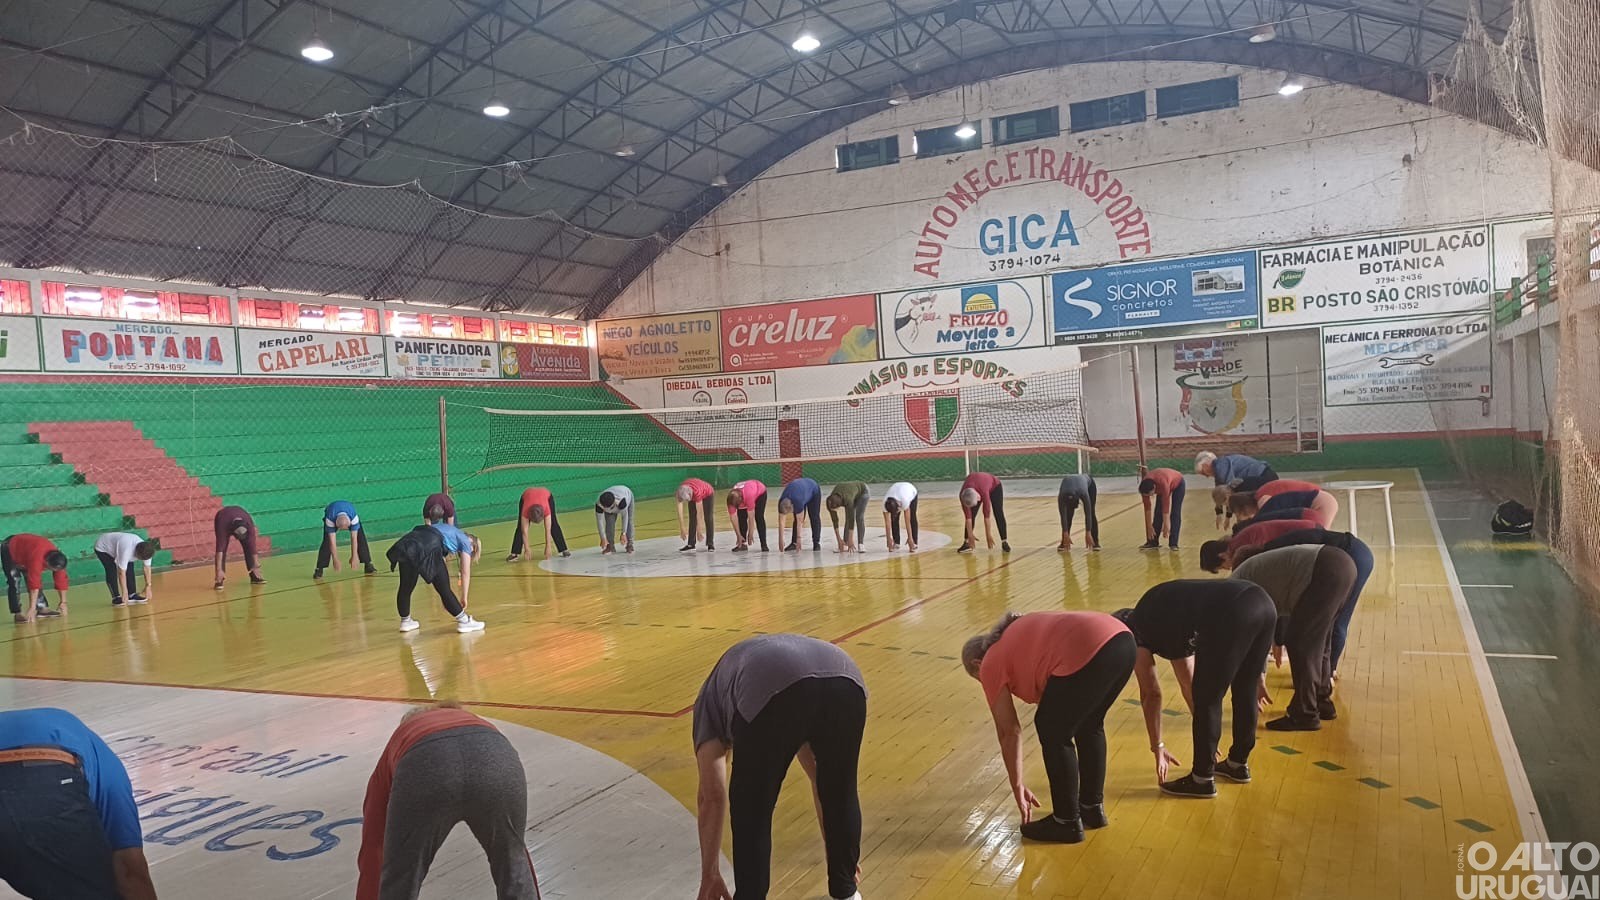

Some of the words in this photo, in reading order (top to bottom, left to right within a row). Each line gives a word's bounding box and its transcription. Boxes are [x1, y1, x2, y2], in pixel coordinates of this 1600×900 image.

[913, 205, 958, 279] AUTO
[1024, 147, 1152, 258] TRANSPORTE
[979, 209, 1080, 256] GICA
[1263, 247, 1342, 269] FARMÁCIA
[1344, 245, 1353, 260] E
[1357, 230, 1486, 259] MANIPULAÇÃO
[989, 253, 1061, 272] 3794-1074
[1375, 274, 1422, 284] 3794-2436
[1107, 279, 1177, 302] SIGNOR
[1268, 296, 1295, 313] BR
[1303, 291, 1362, 310] POSTO
[1366, 285, 1399, 304] SÃO
[1404, 277, 1489, 300] CRISTÓVÃO
[1112, 298, 1173, 312] concretos
[1373, 302, 1419, 312] 3794-1352
[728, 313, 774, 324] GRUPO
[728, 308, 837, 347] creluz
[949, 309, 1009, 328] FRIZZO
[115, 323, 173, 335] MERCADO
[639, 320, 712, 338] AGNOLETTO
[937, 327, 999, 343] Movido
[1005, 327, 1015, 337] a
[1383, 325, 1453, 340] FERRONATO
[1455, 322, 1488, 334] LTDA
[62, 329, 224, 366] FONTANA
[259, 335, 314, 349] MERCADO
[395, 341, 491, 356] PANIFICADORA
[626, 341, 679, 356] VEÍCULOS
[258, 337, 371, 373] CAPELARI
[531, 348, 581, 368] Avenida
[666, 380, 702, 391] DIBEDAL
[706, 377, 744, 388] BEBIDAS
[748, 375, 772, 385] LTDA
[934, 357, 1028, 398] ESPORTES
